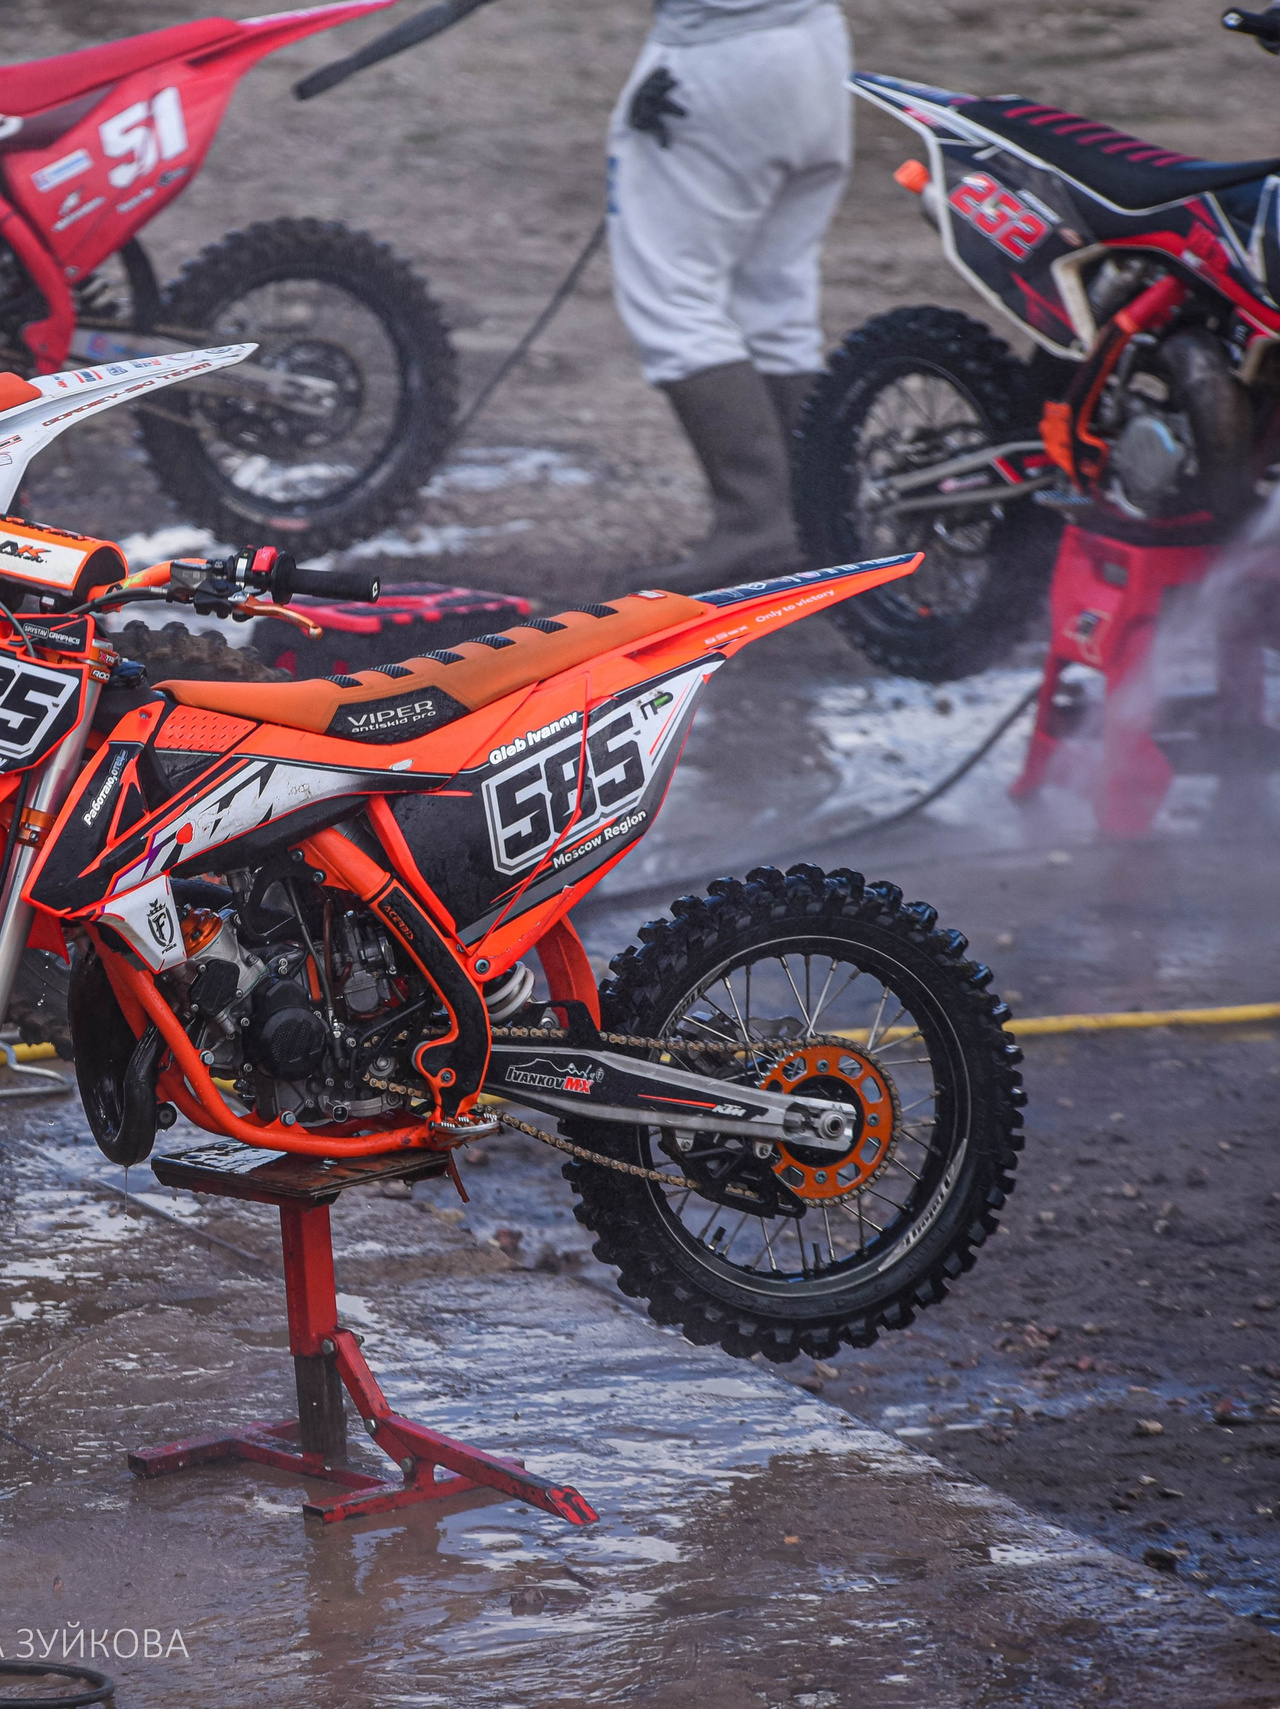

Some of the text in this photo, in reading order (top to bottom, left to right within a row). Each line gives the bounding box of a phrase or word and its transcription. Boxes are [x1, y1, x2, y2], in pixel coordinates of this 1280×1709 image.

[97, 84, 190, 190] 51
[946, 171, 1053, 264] 252
[754, 610, 785, 624] Only
[782, 603, 796, 612] to
[347, 700, 434, 728] VIPER
[351, 709, 437, 734] antiskid pro
[488, 710, 581, 767] Gleb Ivanov
[493, 710, 648, 866] 585
[552, 808, 649, 870] Moscow Region
[712, 1103, 747, 1117] KTM
